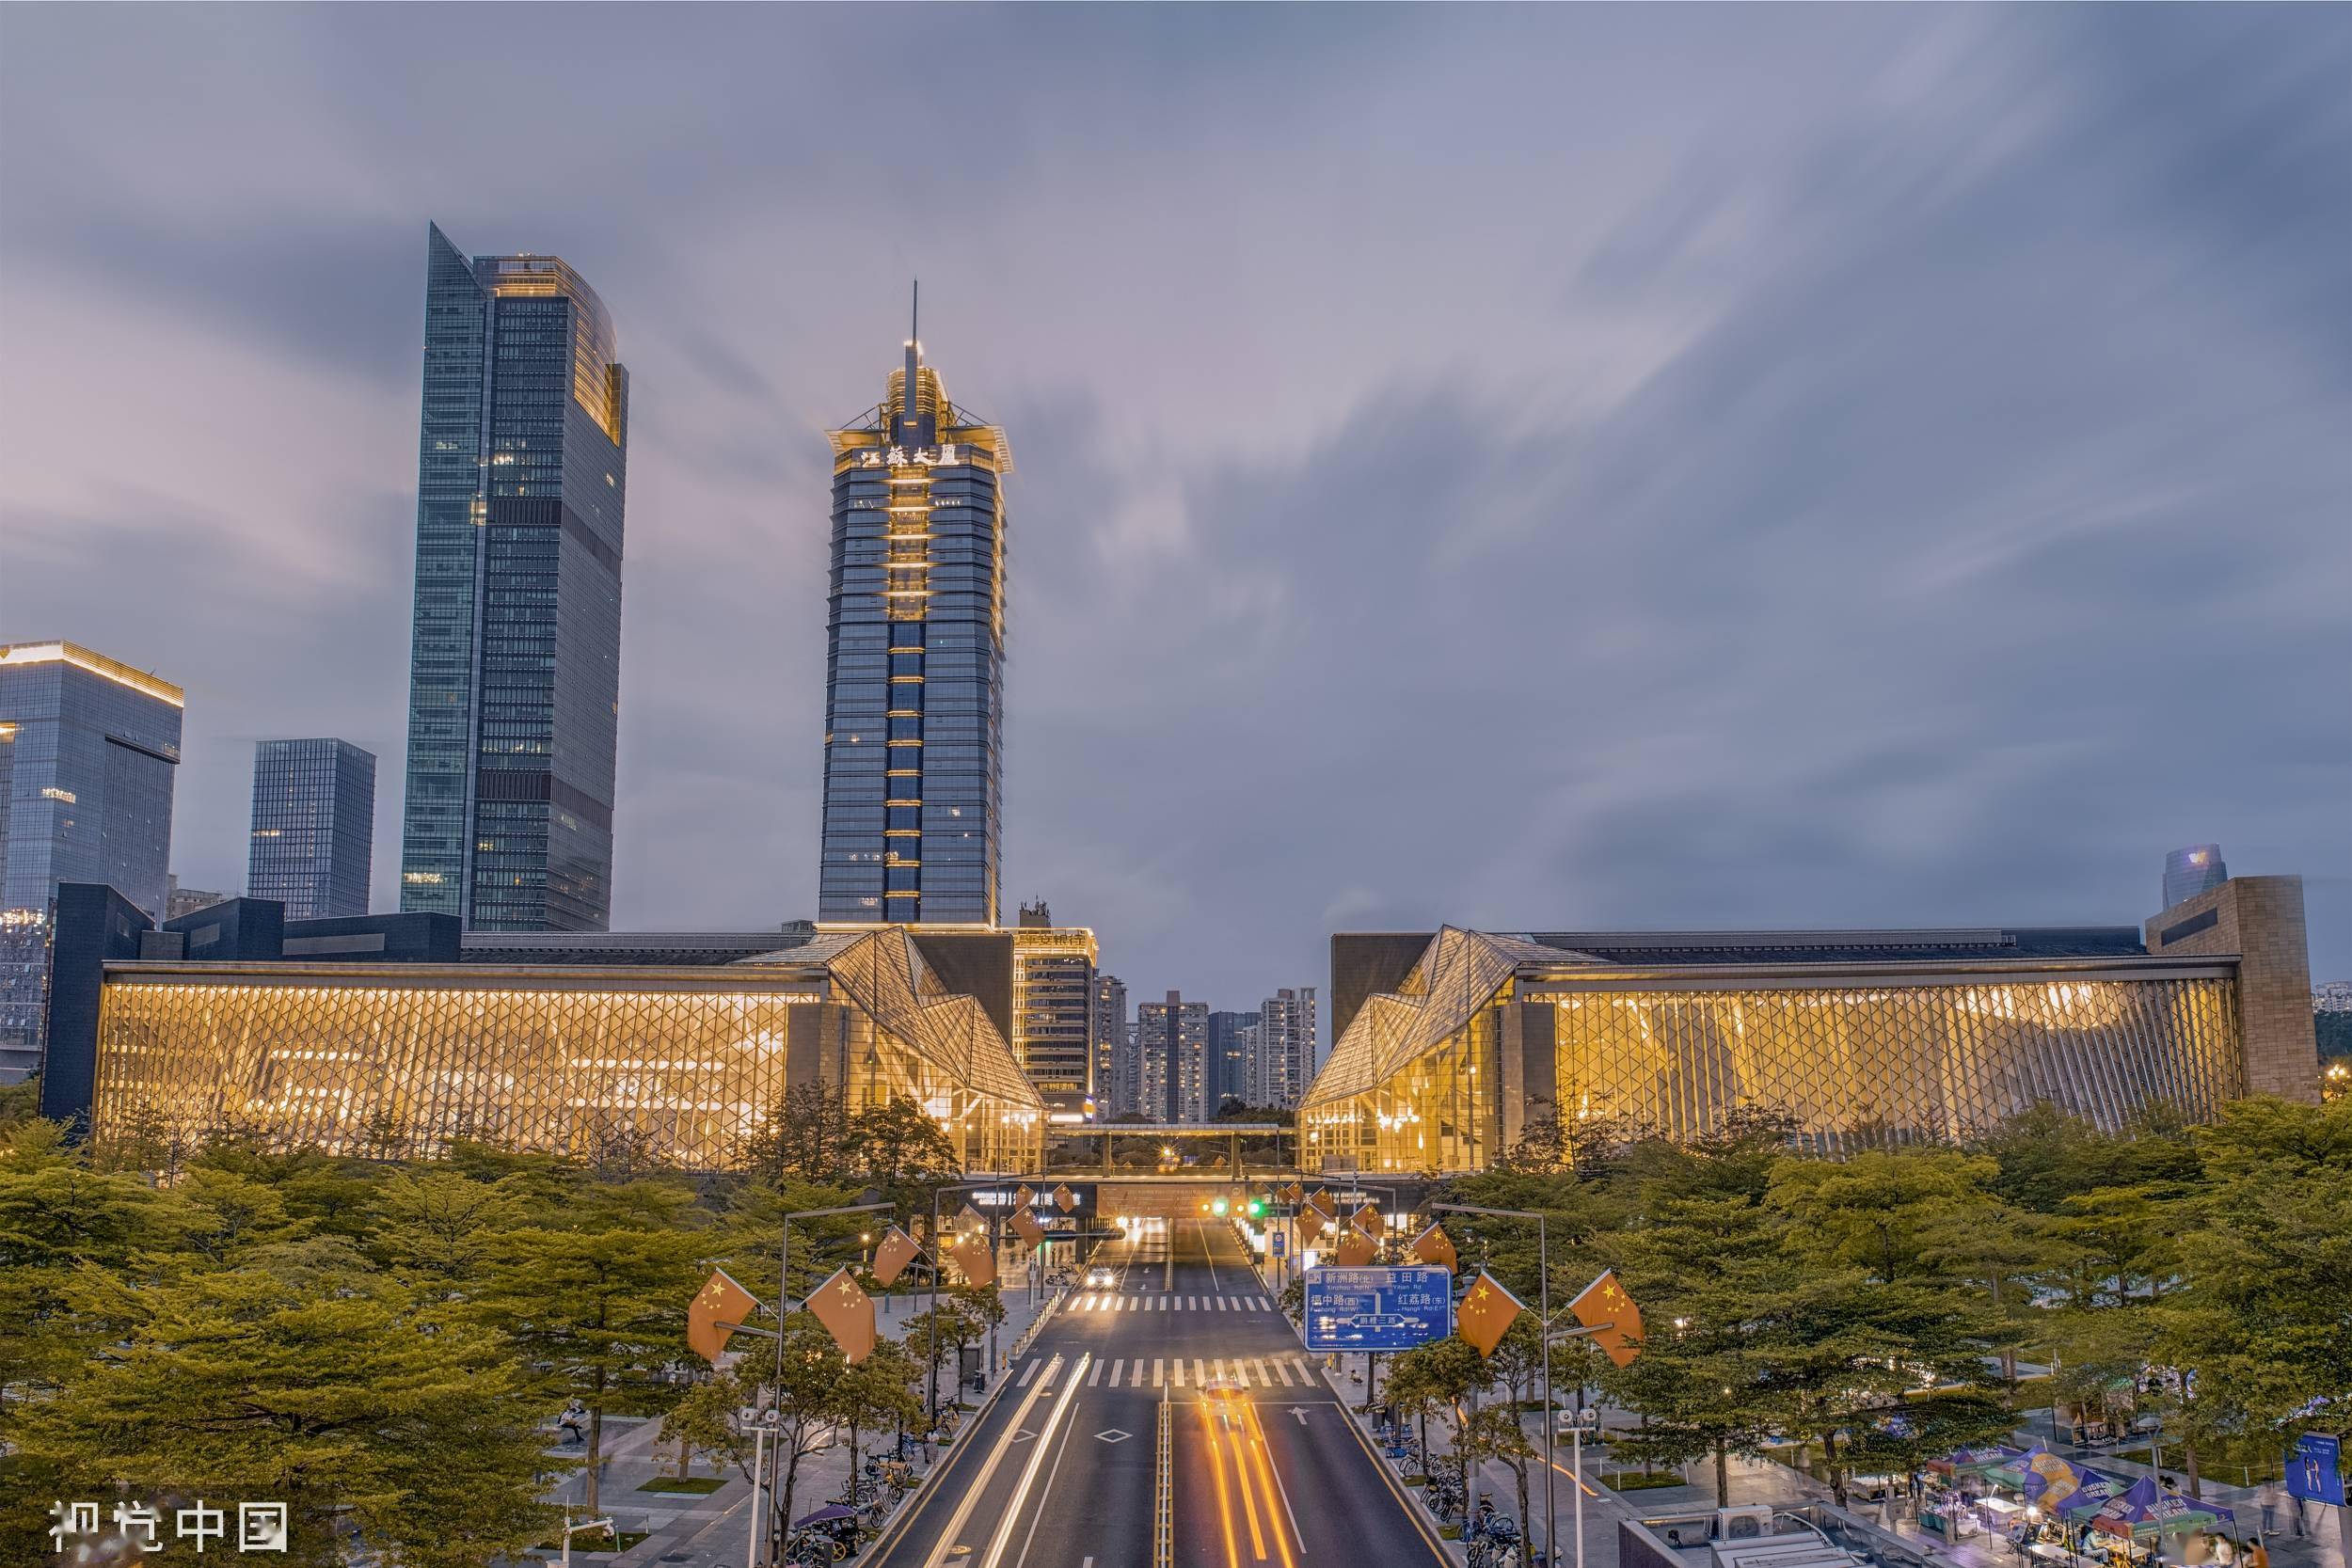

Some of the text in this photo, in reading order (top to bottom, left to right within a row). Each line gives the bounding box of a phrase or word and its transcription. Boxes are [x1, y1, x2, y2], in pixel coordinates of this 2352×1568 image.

[1325, 1272, 1374, 1283] 新洲路(北)
[1385, 1272, 1428, 1283] 益田路
[1311, 1294, 1359, 1306] 福中路(西)
[1398, 1294, 1445, 1306] 红荔路(东)
